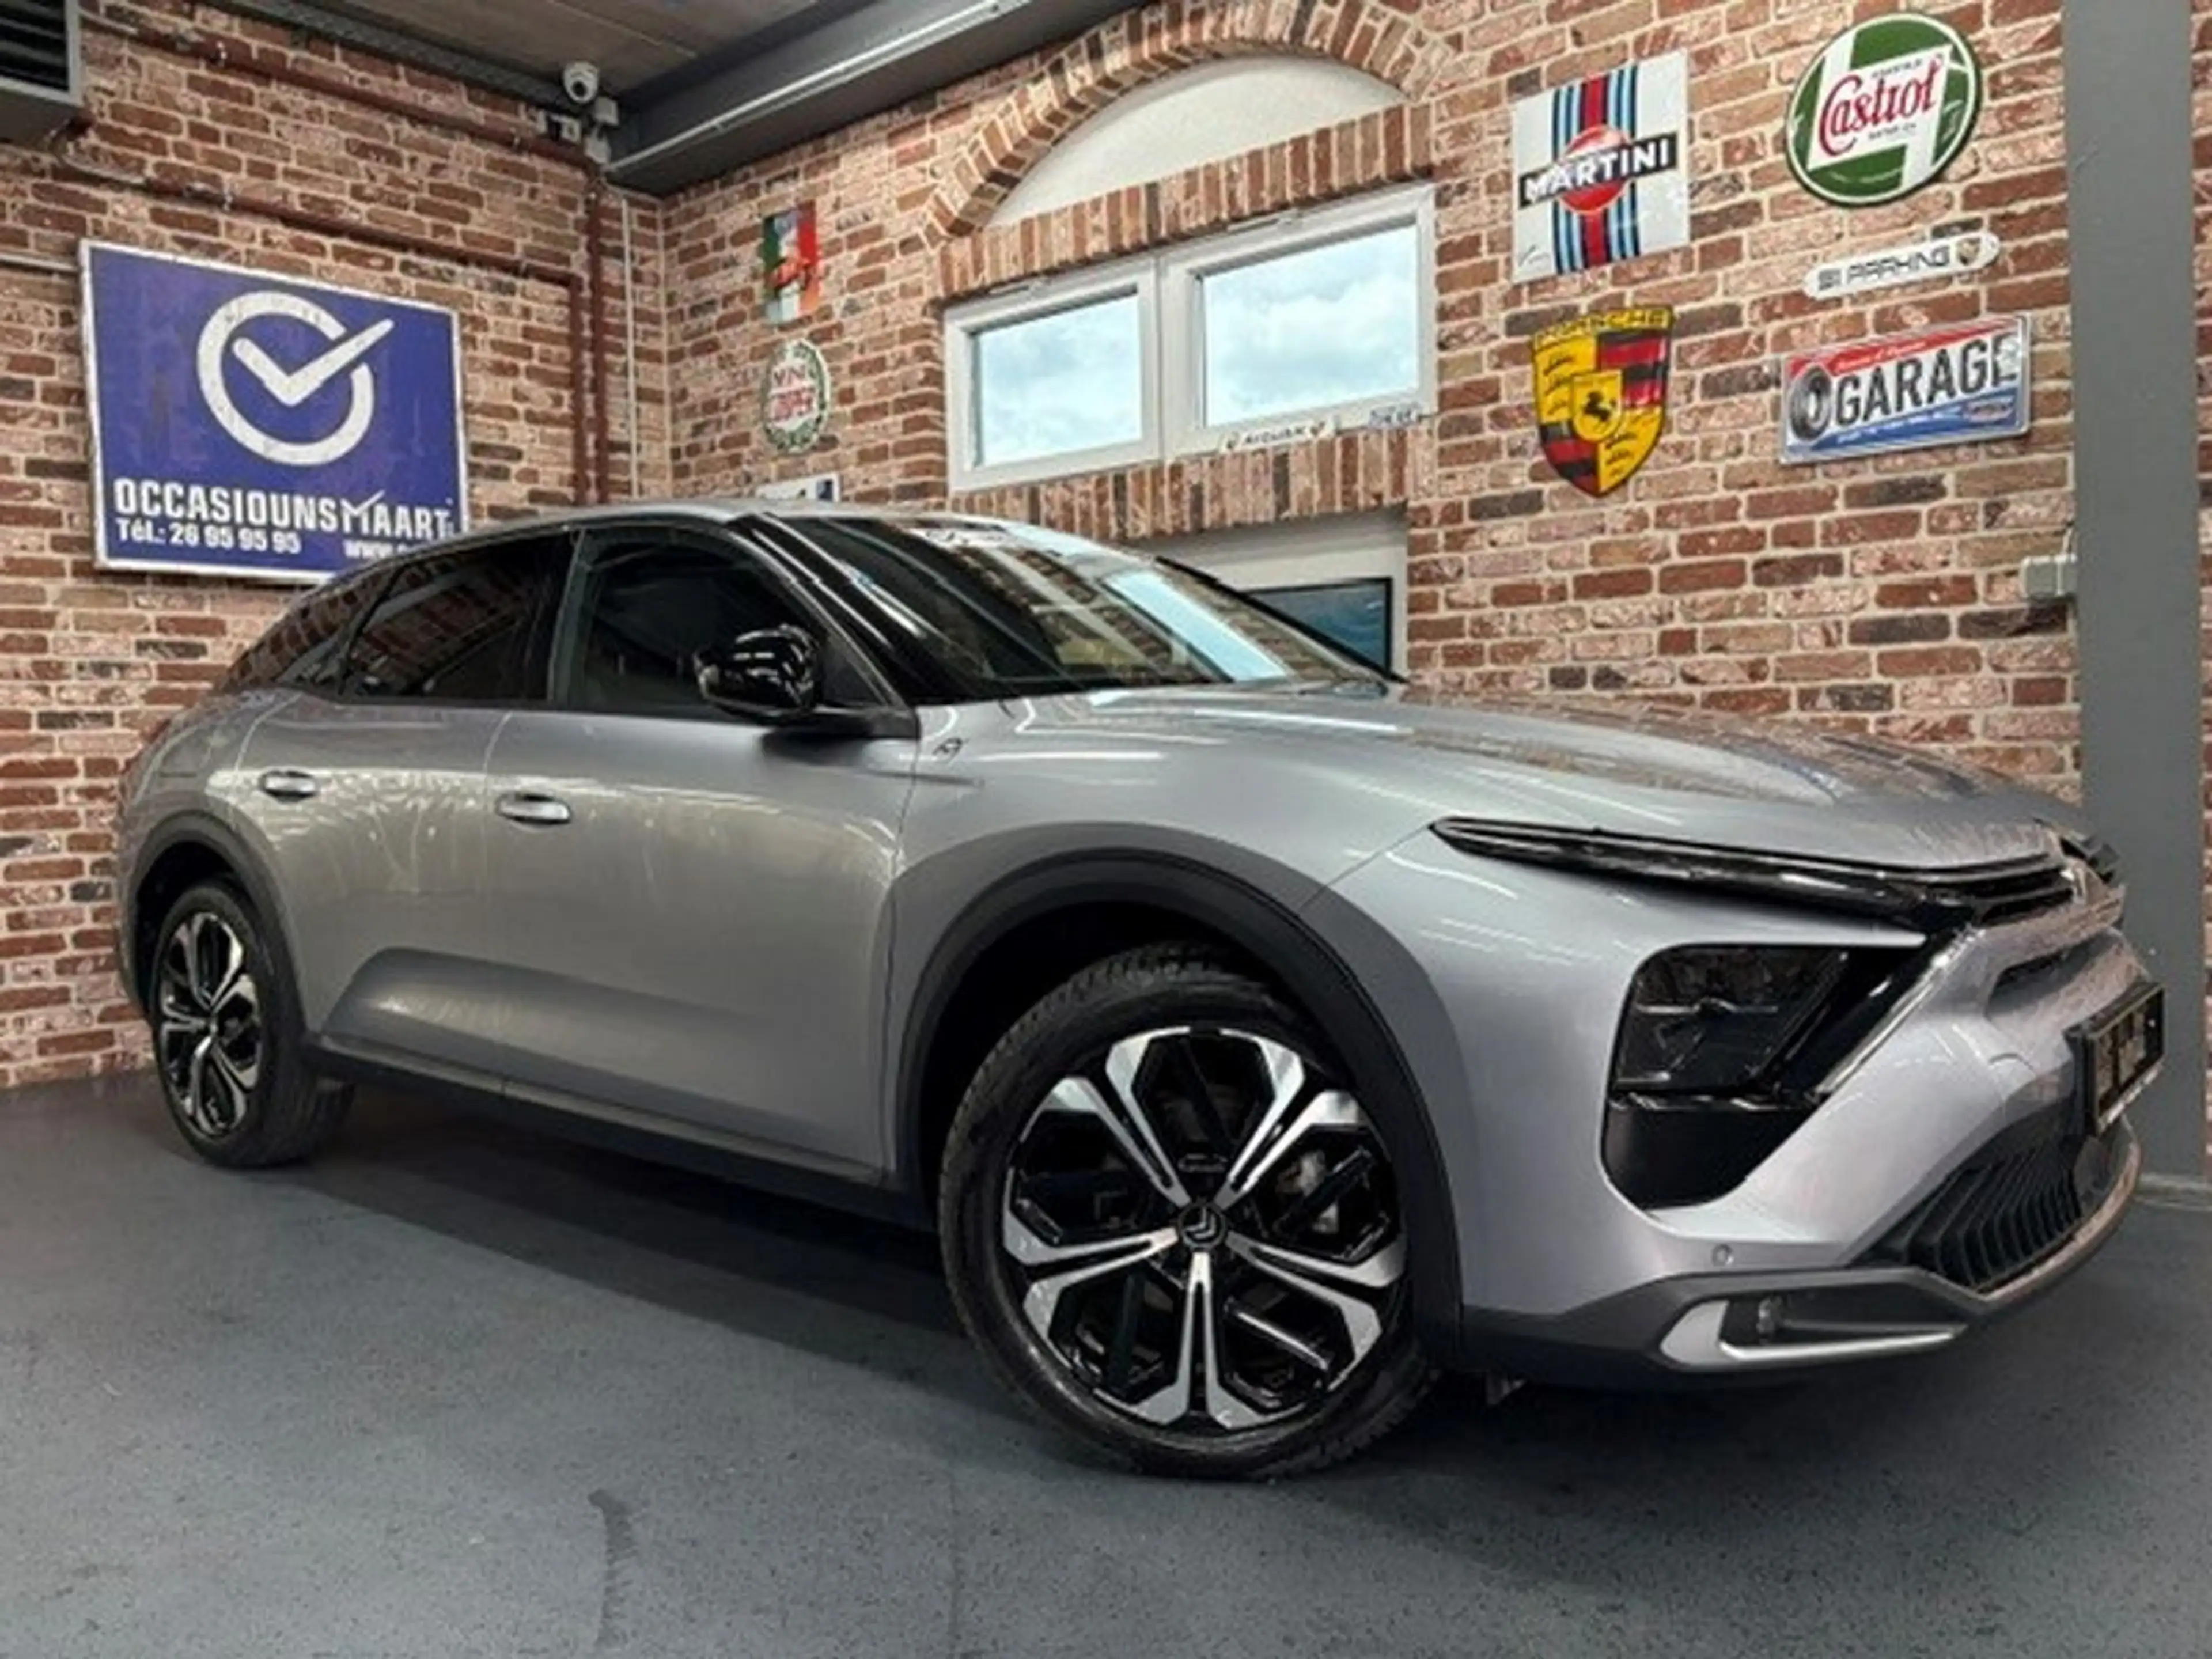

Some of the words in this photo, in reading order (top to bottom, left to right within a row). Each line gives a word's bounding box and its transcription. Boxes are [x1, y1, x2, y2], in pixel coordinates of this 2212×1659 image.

[1819, 54, 1945, 157] Castrol
[1524, 138, 1669, 203] MARTINI
[1836, 332, 2017, 426] GARAGE
[113, 478, 450, 540] OCCASIOUNSMAART
